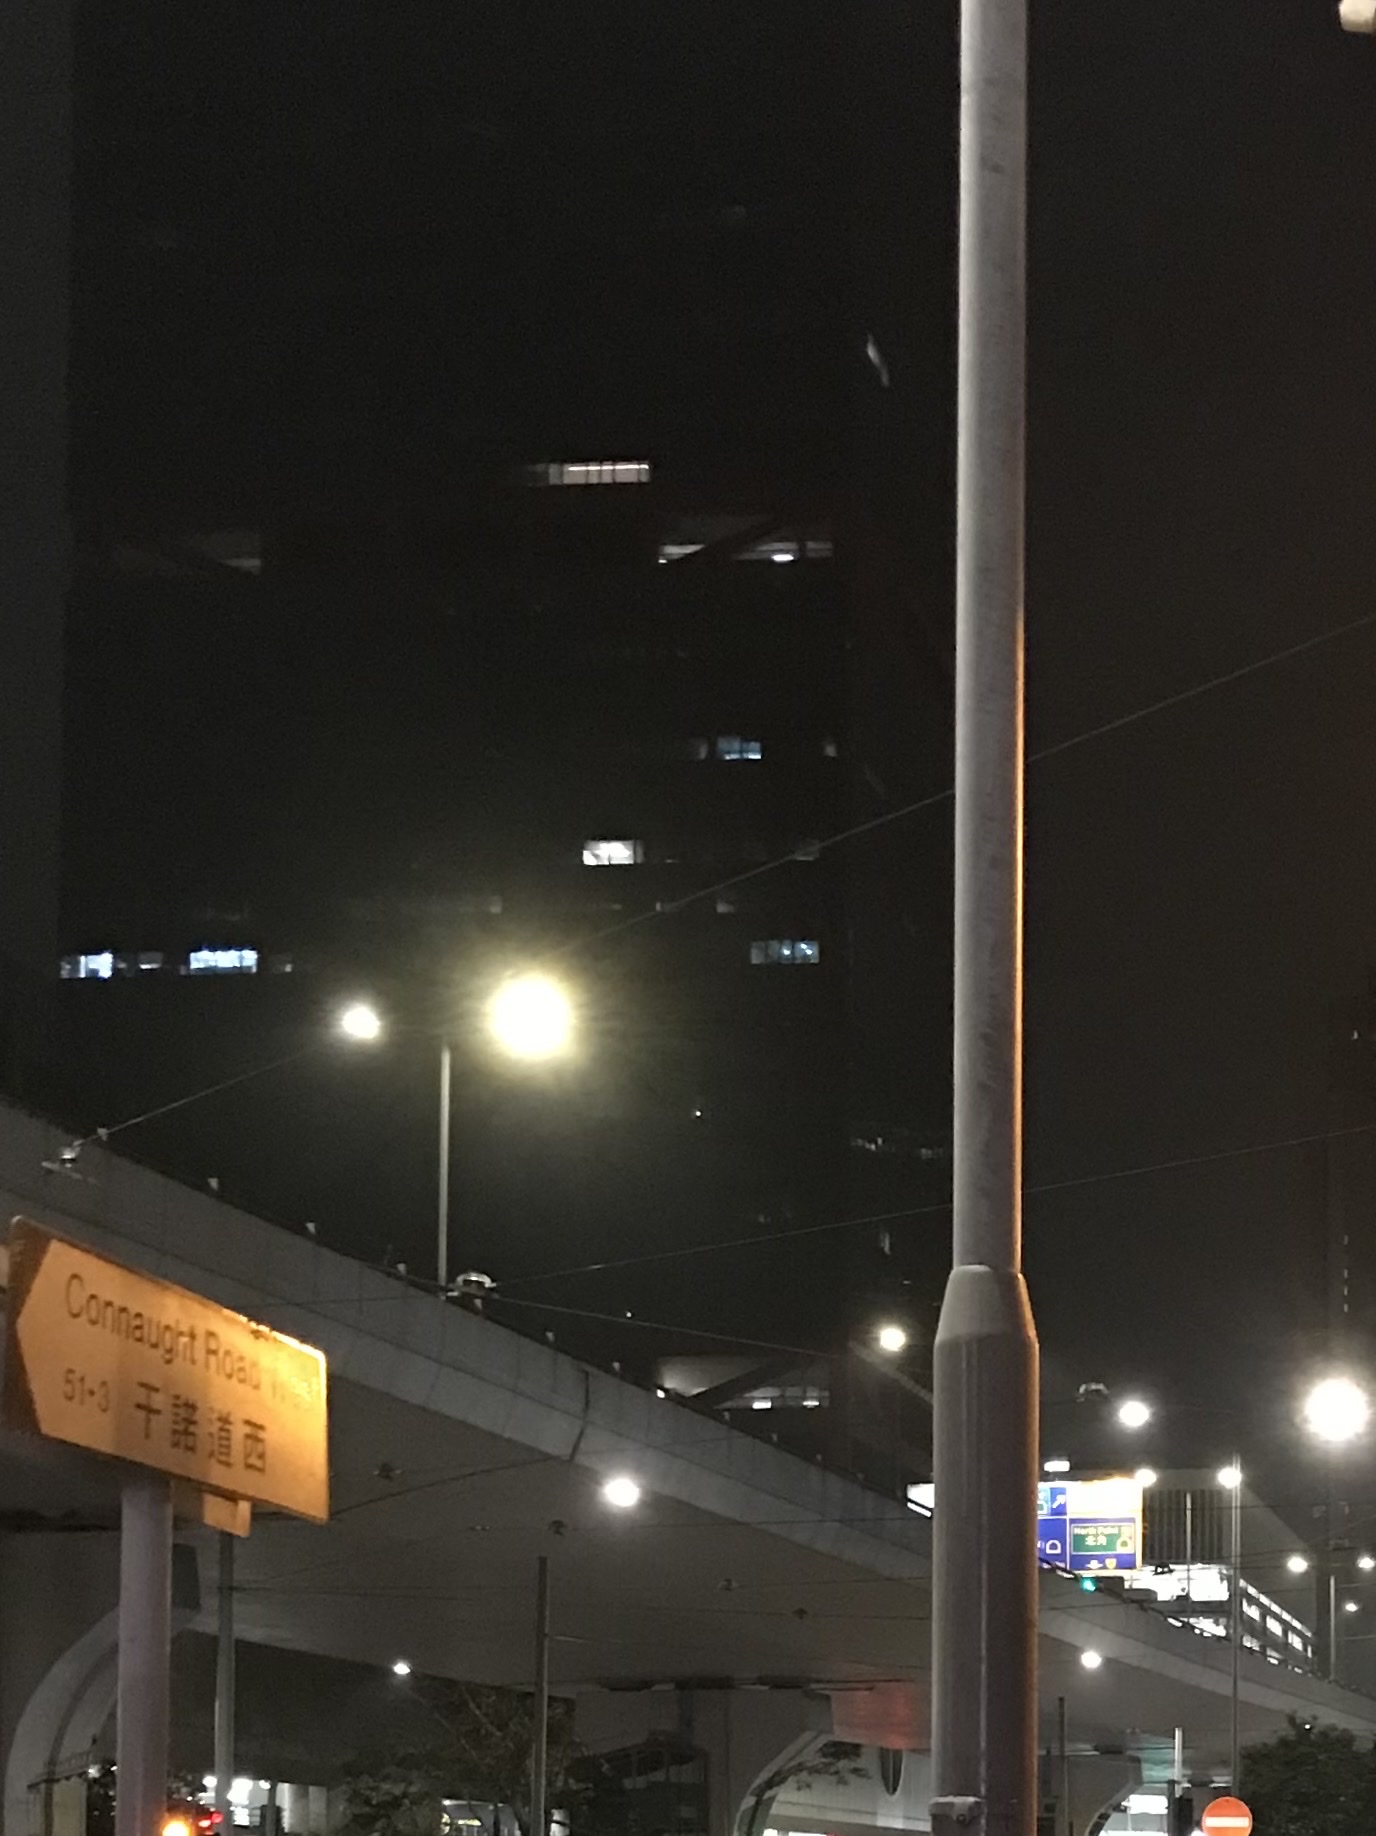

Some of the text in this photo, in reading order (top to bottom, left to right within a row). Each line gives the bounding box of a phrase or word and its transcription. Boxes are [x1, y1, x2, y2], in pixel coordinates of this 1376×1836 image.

[65, 1273, 198, 1365] Connaught
[204, 1330, 262, 1391] Road
[134, 1380, 268, 1474] 干諾道西
[1074, 1526, 1119, 1535] North Point
[1085, 1535, 1107, 1546] 北角
